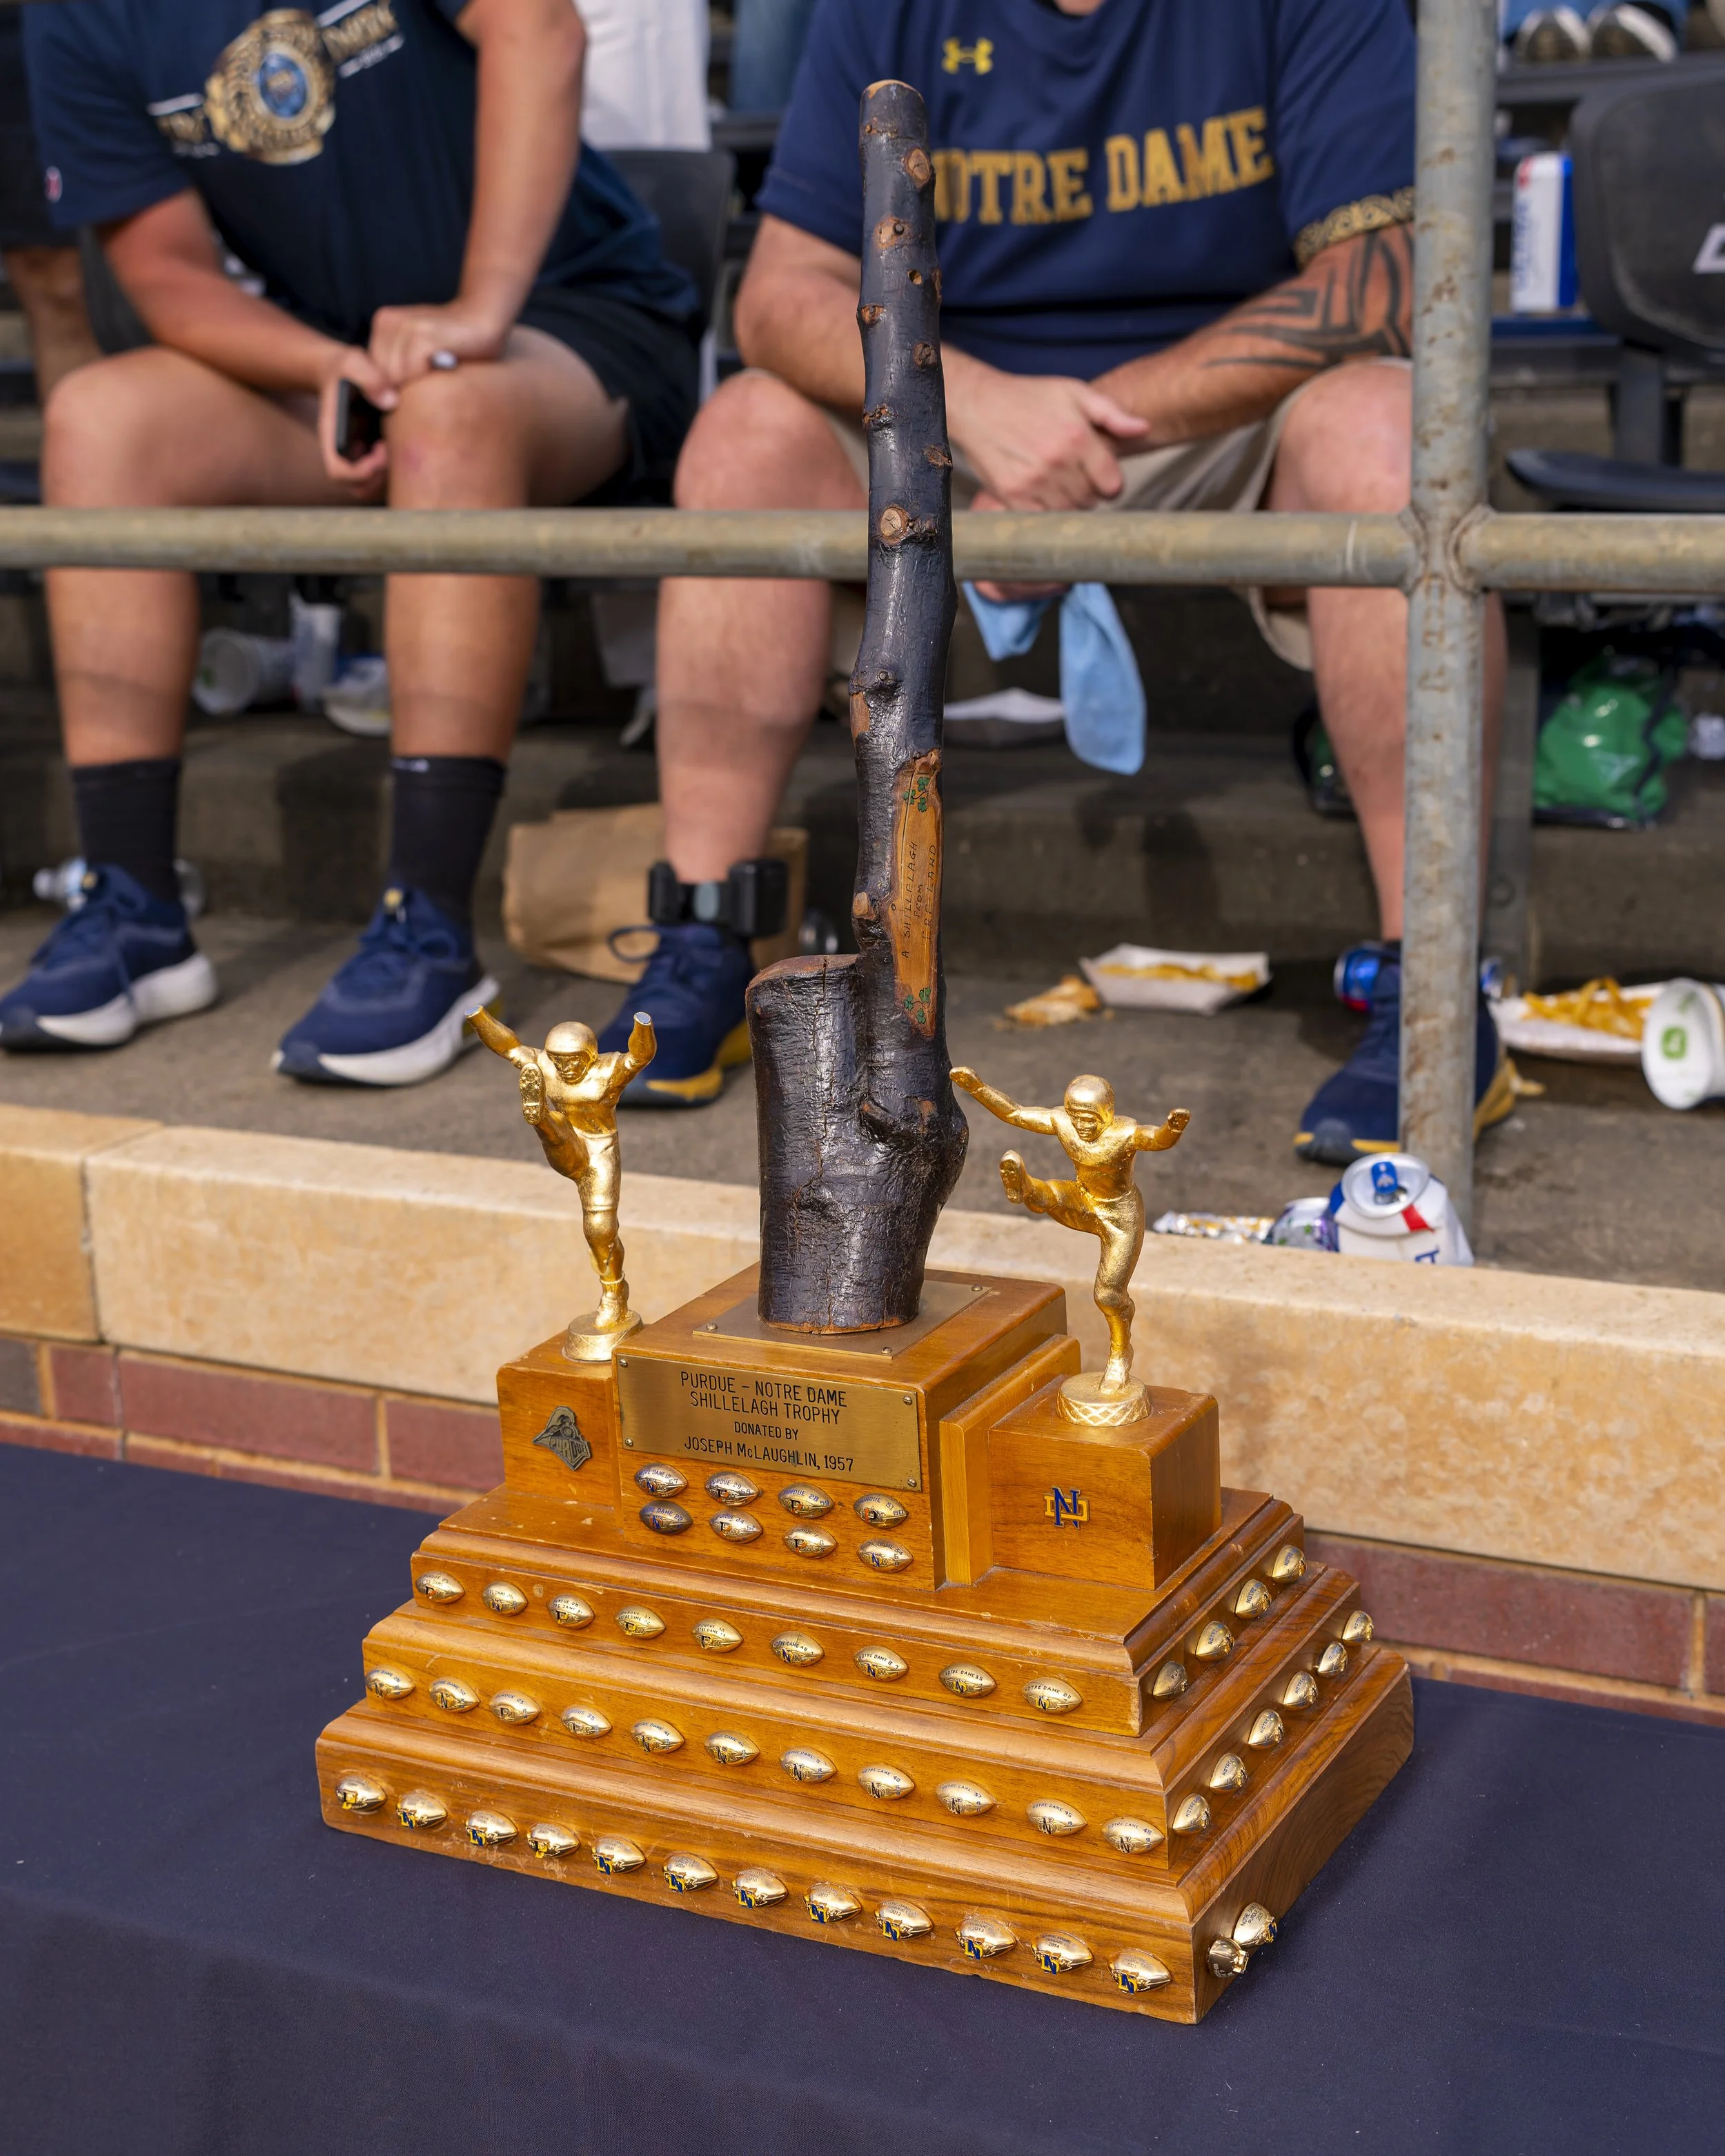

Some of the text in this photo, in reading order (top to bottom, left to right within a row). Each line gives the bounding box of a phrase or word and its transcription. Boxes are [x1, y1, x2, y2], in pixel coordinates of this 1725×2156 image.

[932, 106, 1275, 225] OTRE DAME
[914, 884, 923, 918] FROM
[681, 1372, 736, 1393] PURDUE
[755, 1381, 802, 1401] NOTRE
[807, 1387, 847, 1407] DAME
[691, 1391, 840, 1425] SHILLELAGH TROPHY
[734, 1421, 799, 1441] DONATED BY
[684, 1436, 854, 1472] JOSEPH McLAUGHLIN, 1957
[1043, 1685, 1061, 1694] DAME
